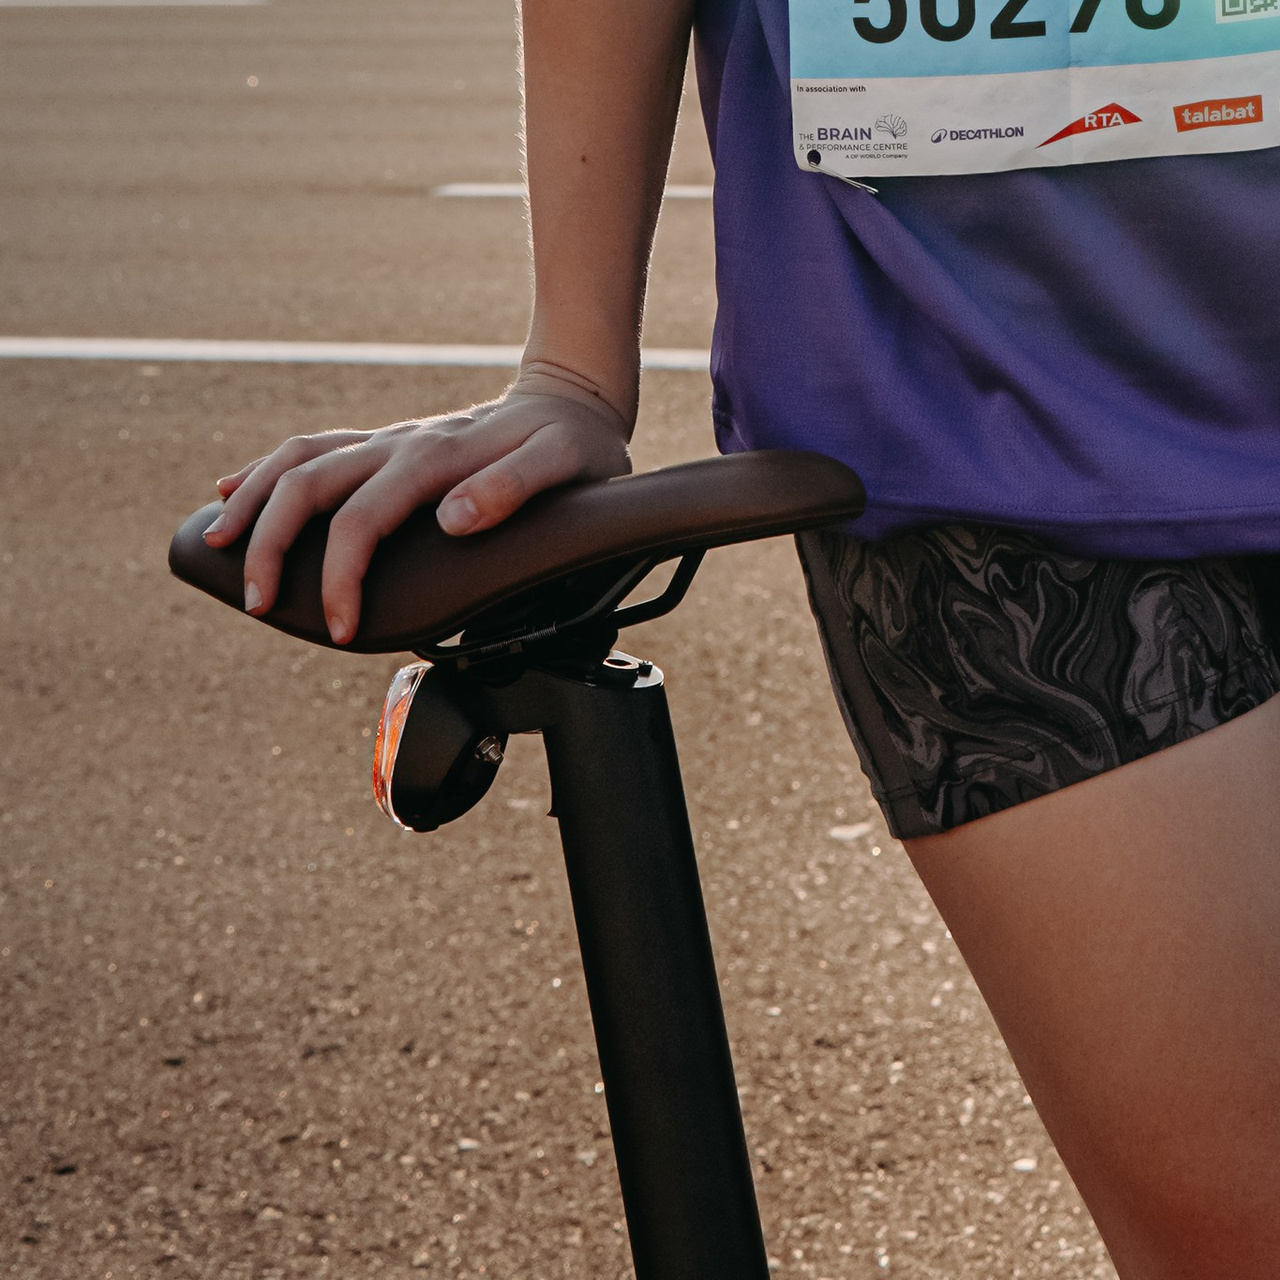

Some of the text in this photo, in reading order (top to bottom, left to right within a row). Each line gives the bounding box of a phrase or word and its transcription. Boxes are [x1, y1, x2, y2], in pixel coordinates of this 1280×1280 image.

[796, 85, 866, 93] In association with
[1182, 101, 1255, 124] talabat
[1084, 112, 1125, 128] RTA
[799, 127, 872, 141] THE BRAIN
[950, 126, 1024, 141] DECATHLON
[806, 143, 871, 151] PERFORMANCE
[873, 142, 908, 151] CENTRE
